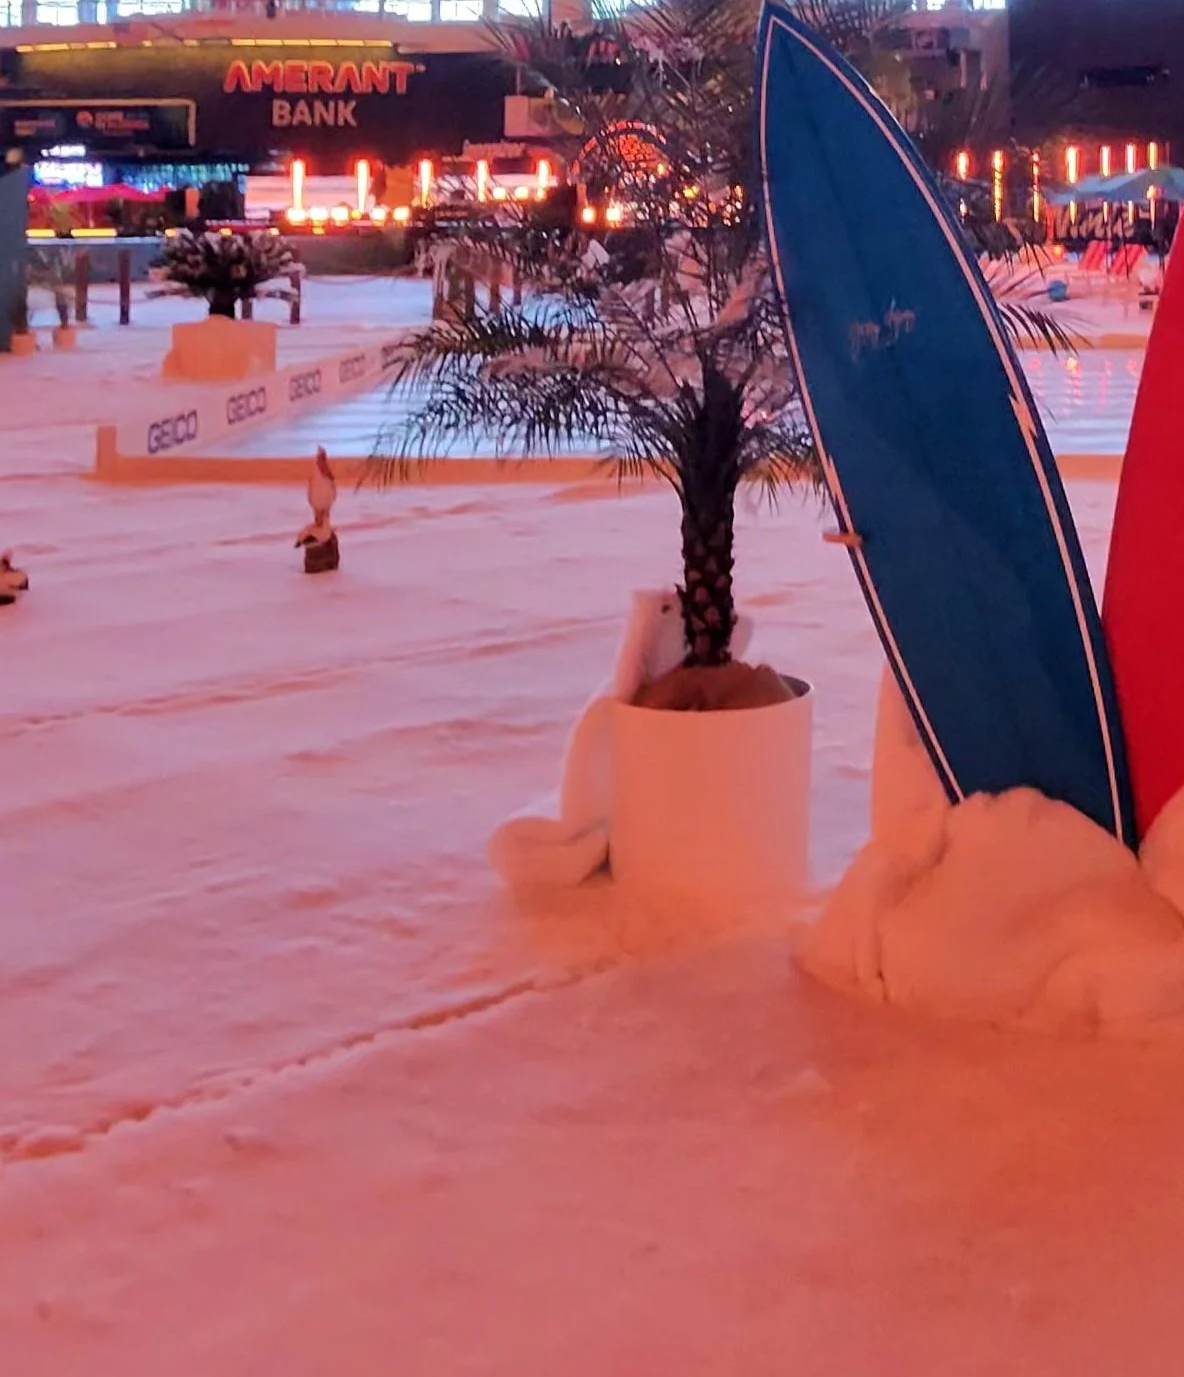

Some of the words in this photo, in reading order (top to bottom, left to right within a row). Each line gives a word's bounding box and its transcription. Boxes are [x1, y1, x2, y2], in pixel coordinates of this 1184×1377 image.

[223, 60, 413, 95] AMERANT
[272, 99, 357, 127] BANK
[289, 369, 321, 401] GEICO
[227, 387, 267, 425] GEICO
[148, 410, 197, 454] GEICO
